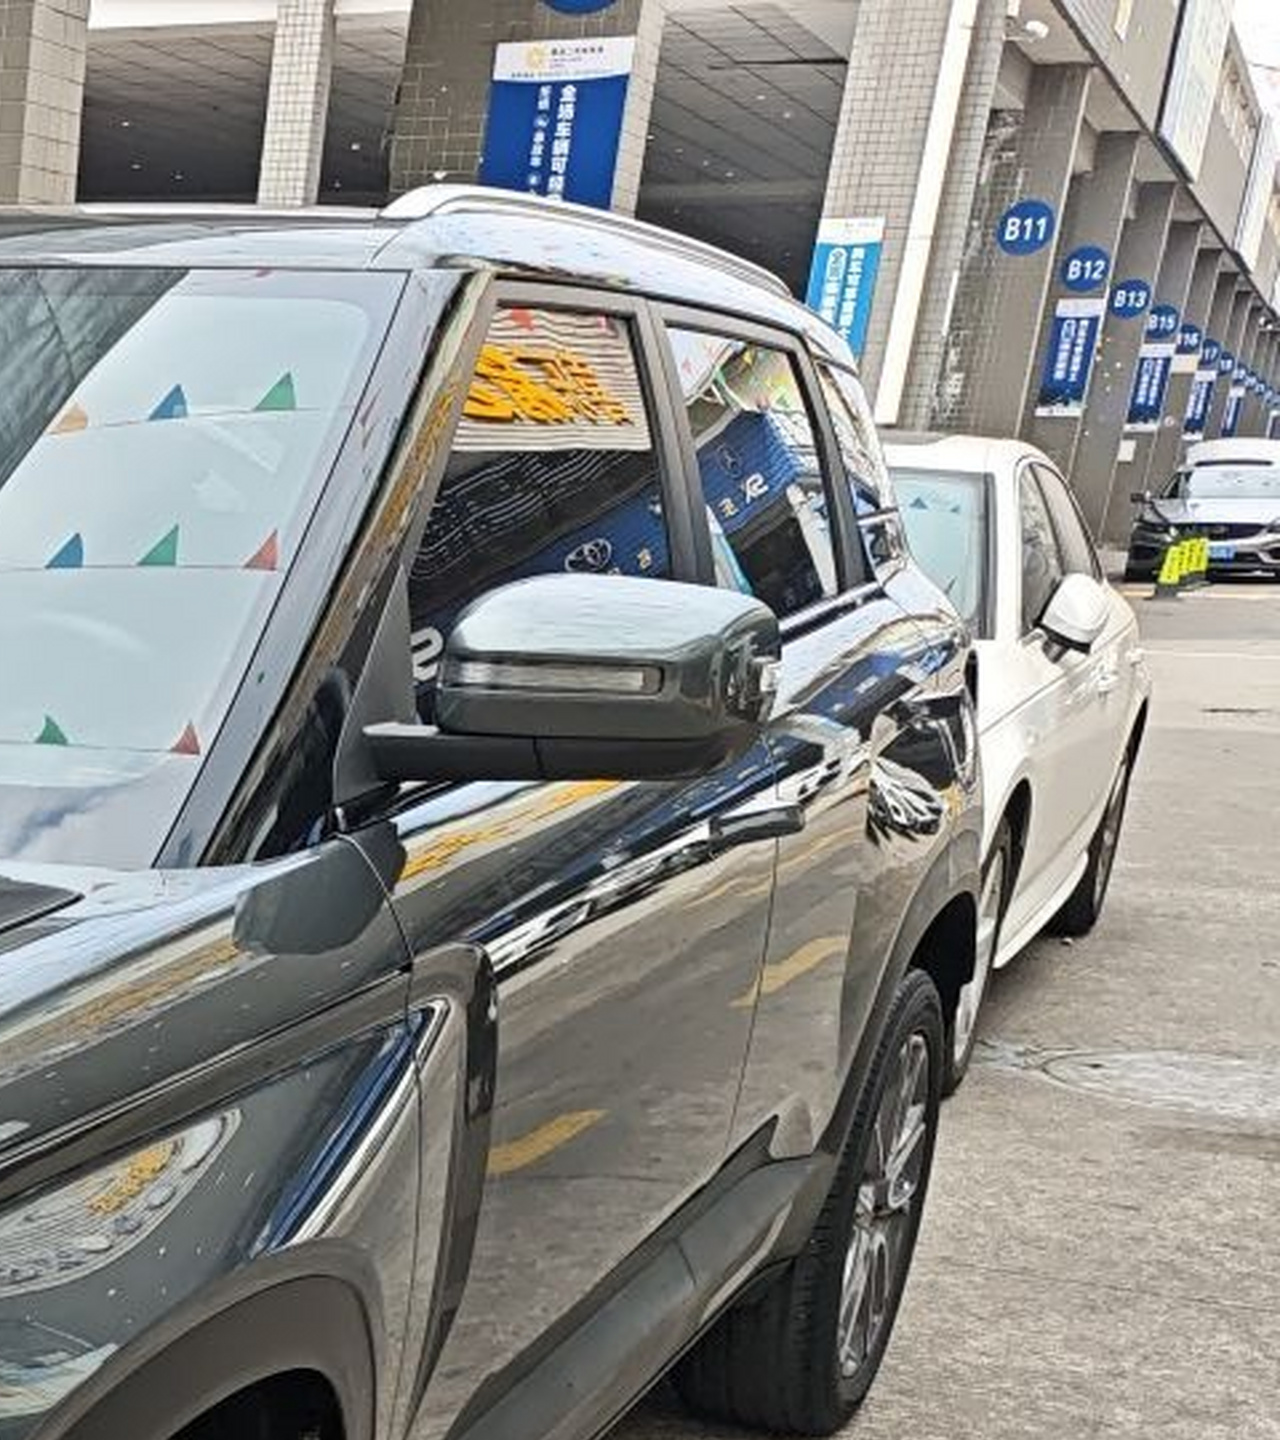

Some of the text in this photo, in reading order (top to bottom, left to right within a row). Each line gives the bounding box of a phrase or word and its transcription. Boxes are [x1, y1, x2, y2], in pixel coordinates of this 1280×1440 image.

[1004, 216, 1047, 241] B11
[1066, 259, 1106, 281] B12
[1113, 289, 1147, 308] B13
[1148, 314, 1176, 331] B15
[1176, 332, 1200, 347] 16
